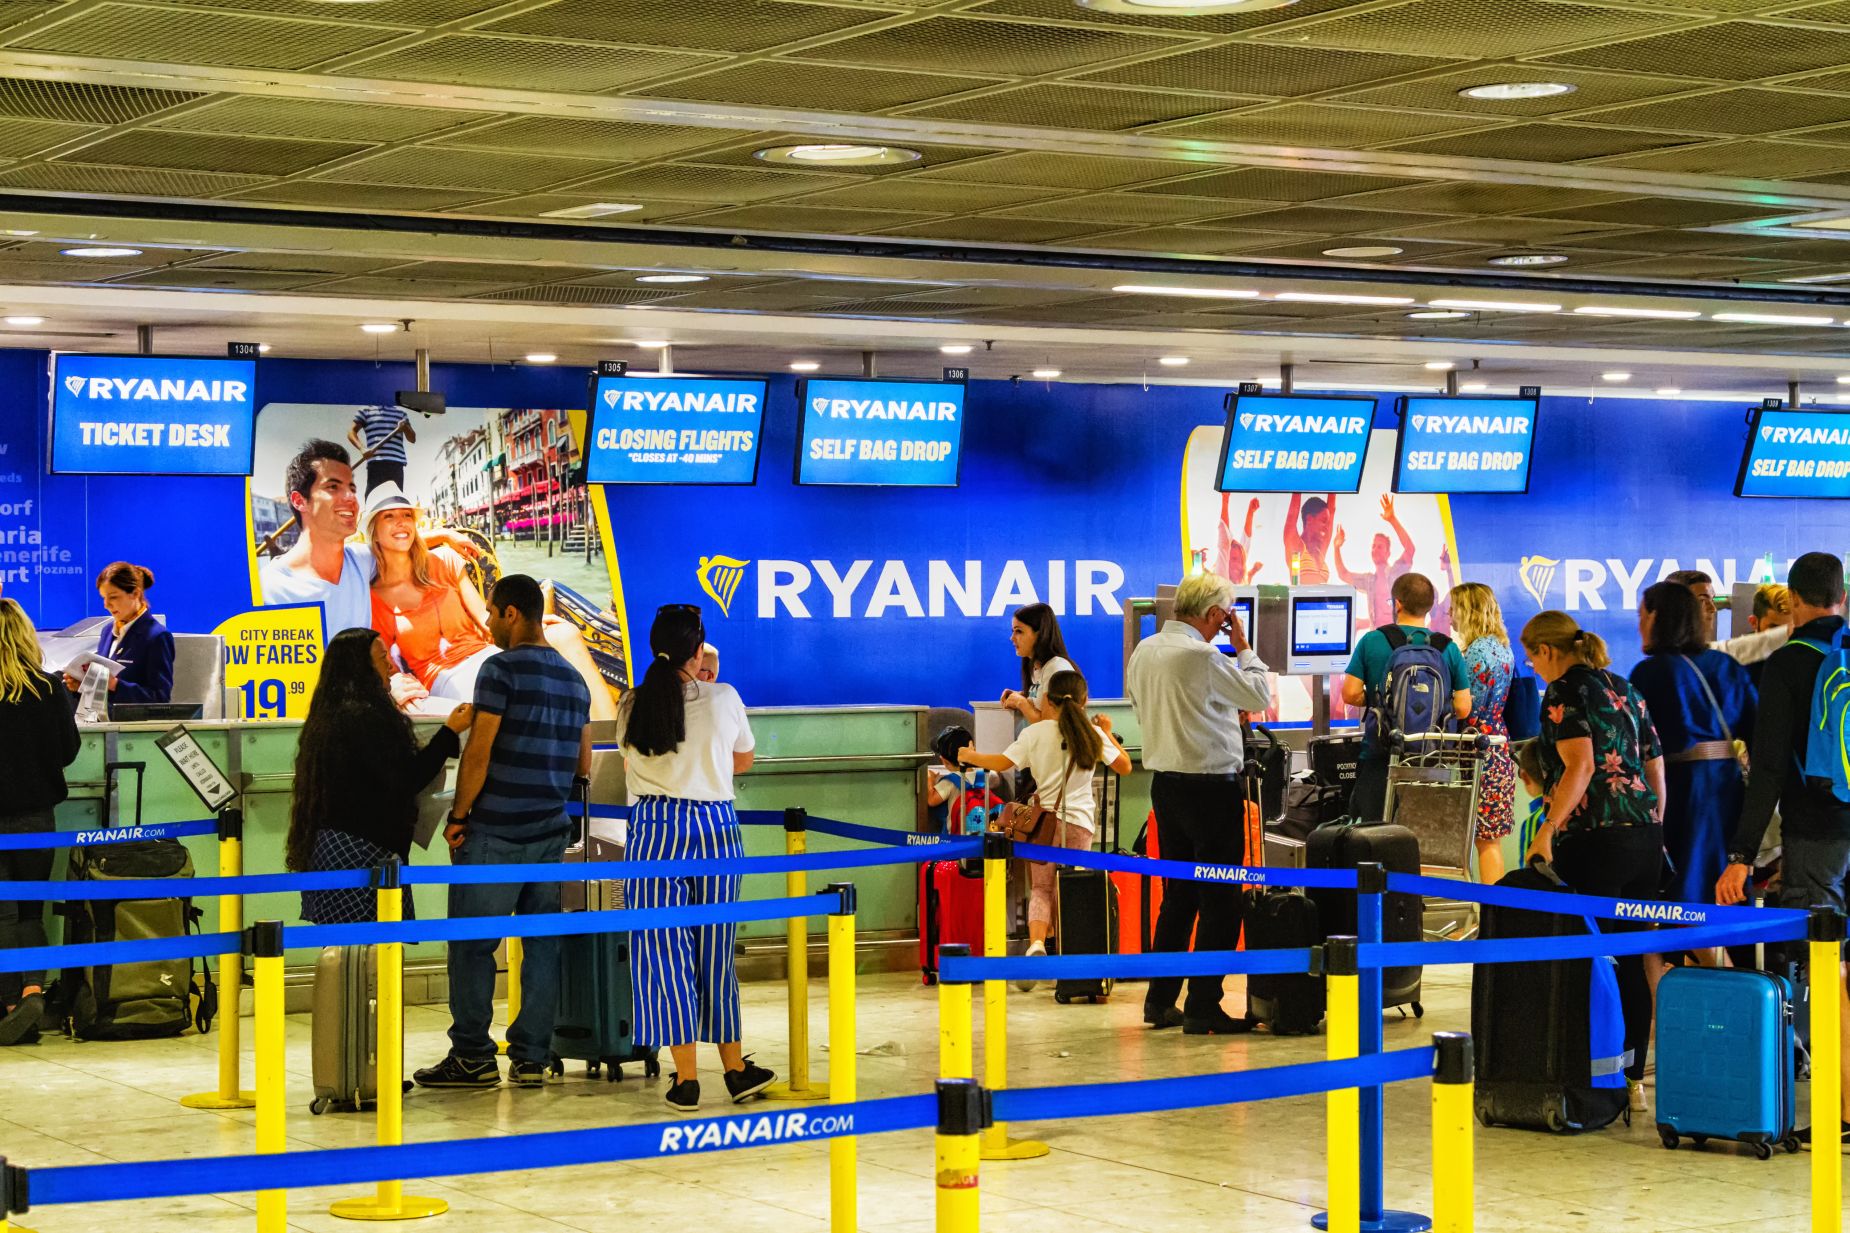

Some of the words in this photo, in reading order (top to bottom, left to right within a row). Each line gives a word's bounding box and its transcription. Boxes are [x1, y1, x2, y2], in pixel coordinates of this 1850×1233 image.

[235, 345, 254, 355] 1304
[604, 363, 621, 372] 1305
[948, 370, 964, 379] 1306
[89, 377, 247, 402] RYANAIR
[1244, 384, 1258, 392] 1307
[622, 391, 758, 413] RYANAIR
[830, 399, 957, 422] RYANAIR
[1254, 414, 1366, 435] RYANAIR
[1425, 415, 1530, 435] RYANAIR
[79, 422, 164, 446] TICKET
[168, 423, 231, 448] DESK
[597, 428, 676, 451] CLOSING
[678, 429, 754, 452] FLIGHTS
[1772, 426, 1850, 445] RYANAI
[666, 453, 678, 463] AT
[809, 438, 857, 460] SELF
[859, 439, 898, 461] BAG
[900, 441, 952, 462] DROP
[1232, 449, 1274, 470] SELF
[1274, 450, 1309, 470] BAG
[1310, 451, 1357, 471] DROP
[1407, 451, 1446, 471] SELF
[1447, 451, 1480, 471] BAG
[1481, 452, 1524, 471] DROP
[1751, 458, 1788, 477] SELF
[1786, 459, 1816, 478] BAG
[1815, 460, 1850, 478] DROP
[0, 545, 72, 563] nerife
[34, 564, 83, 575] Poznan
[757, 559, 1126, 619] RYANAIR
[240, 629, 269, 641] CITY
[272, 628, 315, 641] BREAK
[256, 644, 318, 665] FARES
[76, 827, 165, 844] RYANAIR.COM
[1194, 865, 1266, 883] RYANAIR.COM
[1615, 902, 1706, 922] RYANAIR.COM
[659, 1113, 854, 1152] RYANAIR.COM
